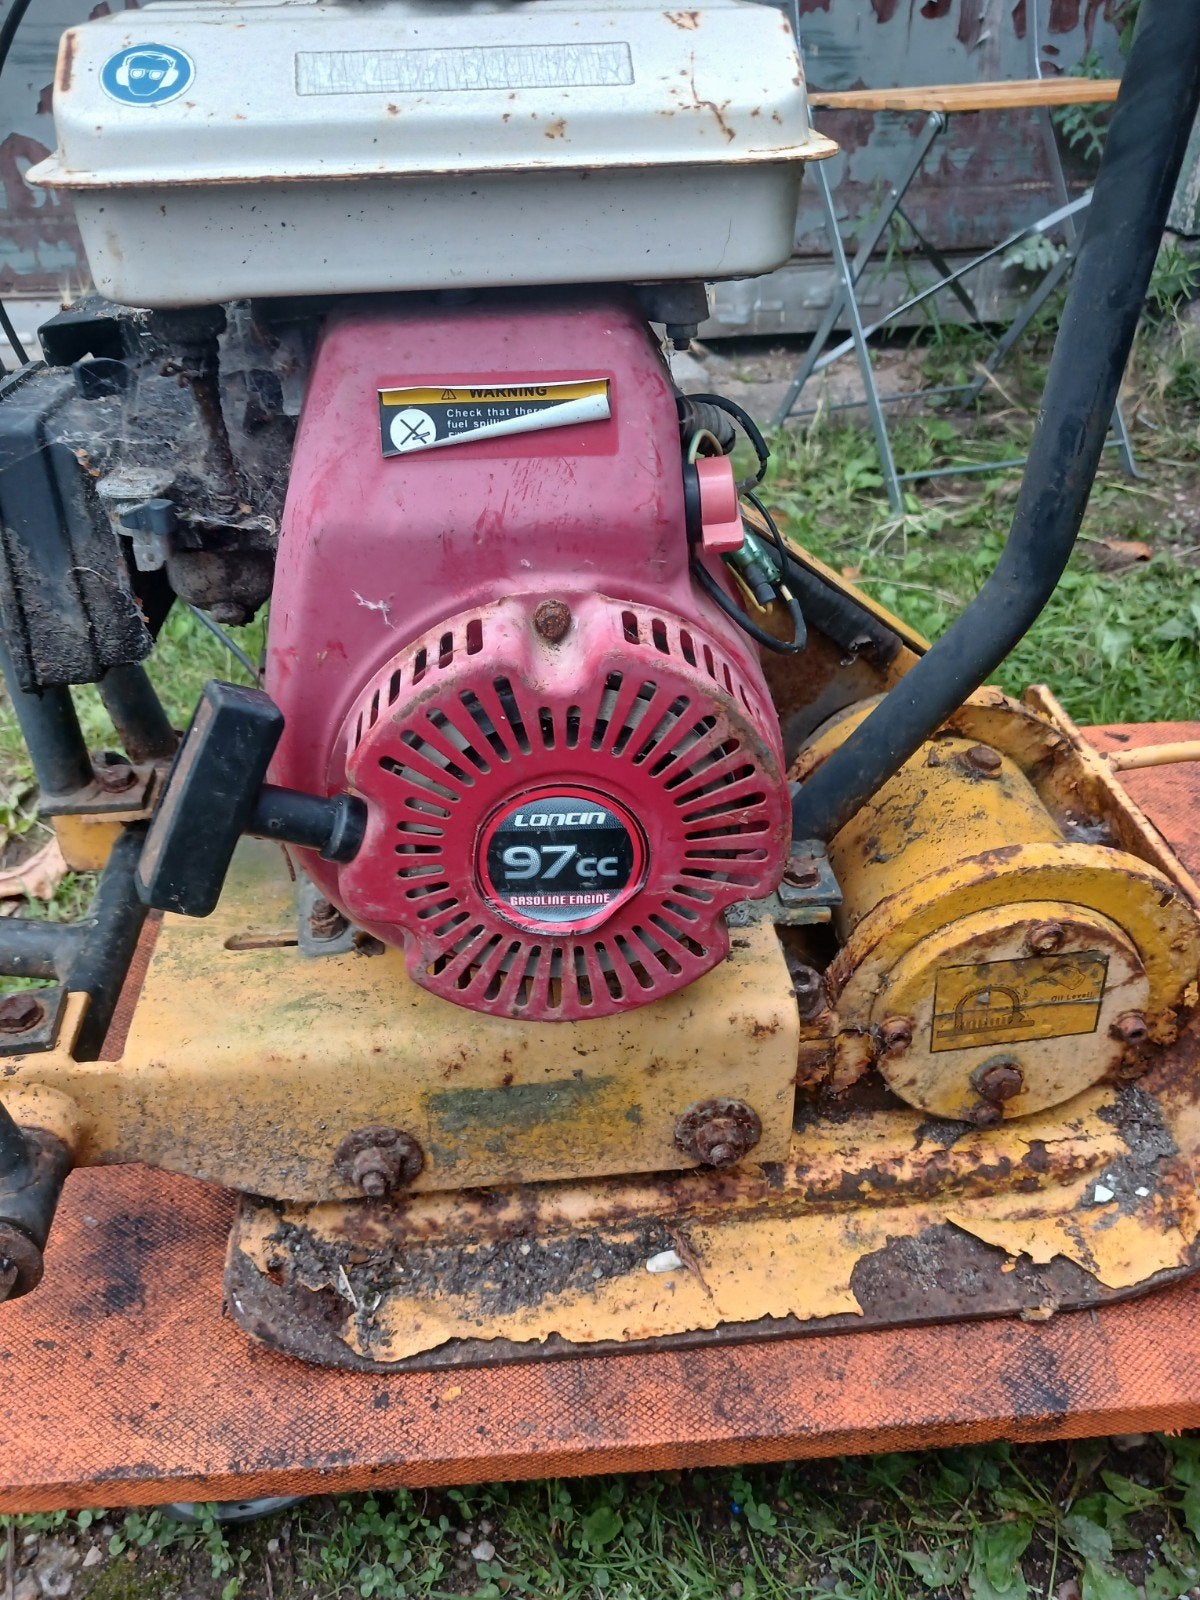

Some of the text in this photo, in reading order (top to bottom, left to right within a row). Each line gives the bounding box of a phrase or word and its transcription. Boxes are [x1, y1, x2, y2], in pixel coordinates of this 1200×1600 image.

[470, 387, 547, 398] WARNING
[446, 408, 482, 418] Check
[488, 407, 510, 417] that
[447, 419, 468, 429] fuel
[510, 894, 611, 906] GASOLINE ENGINE
